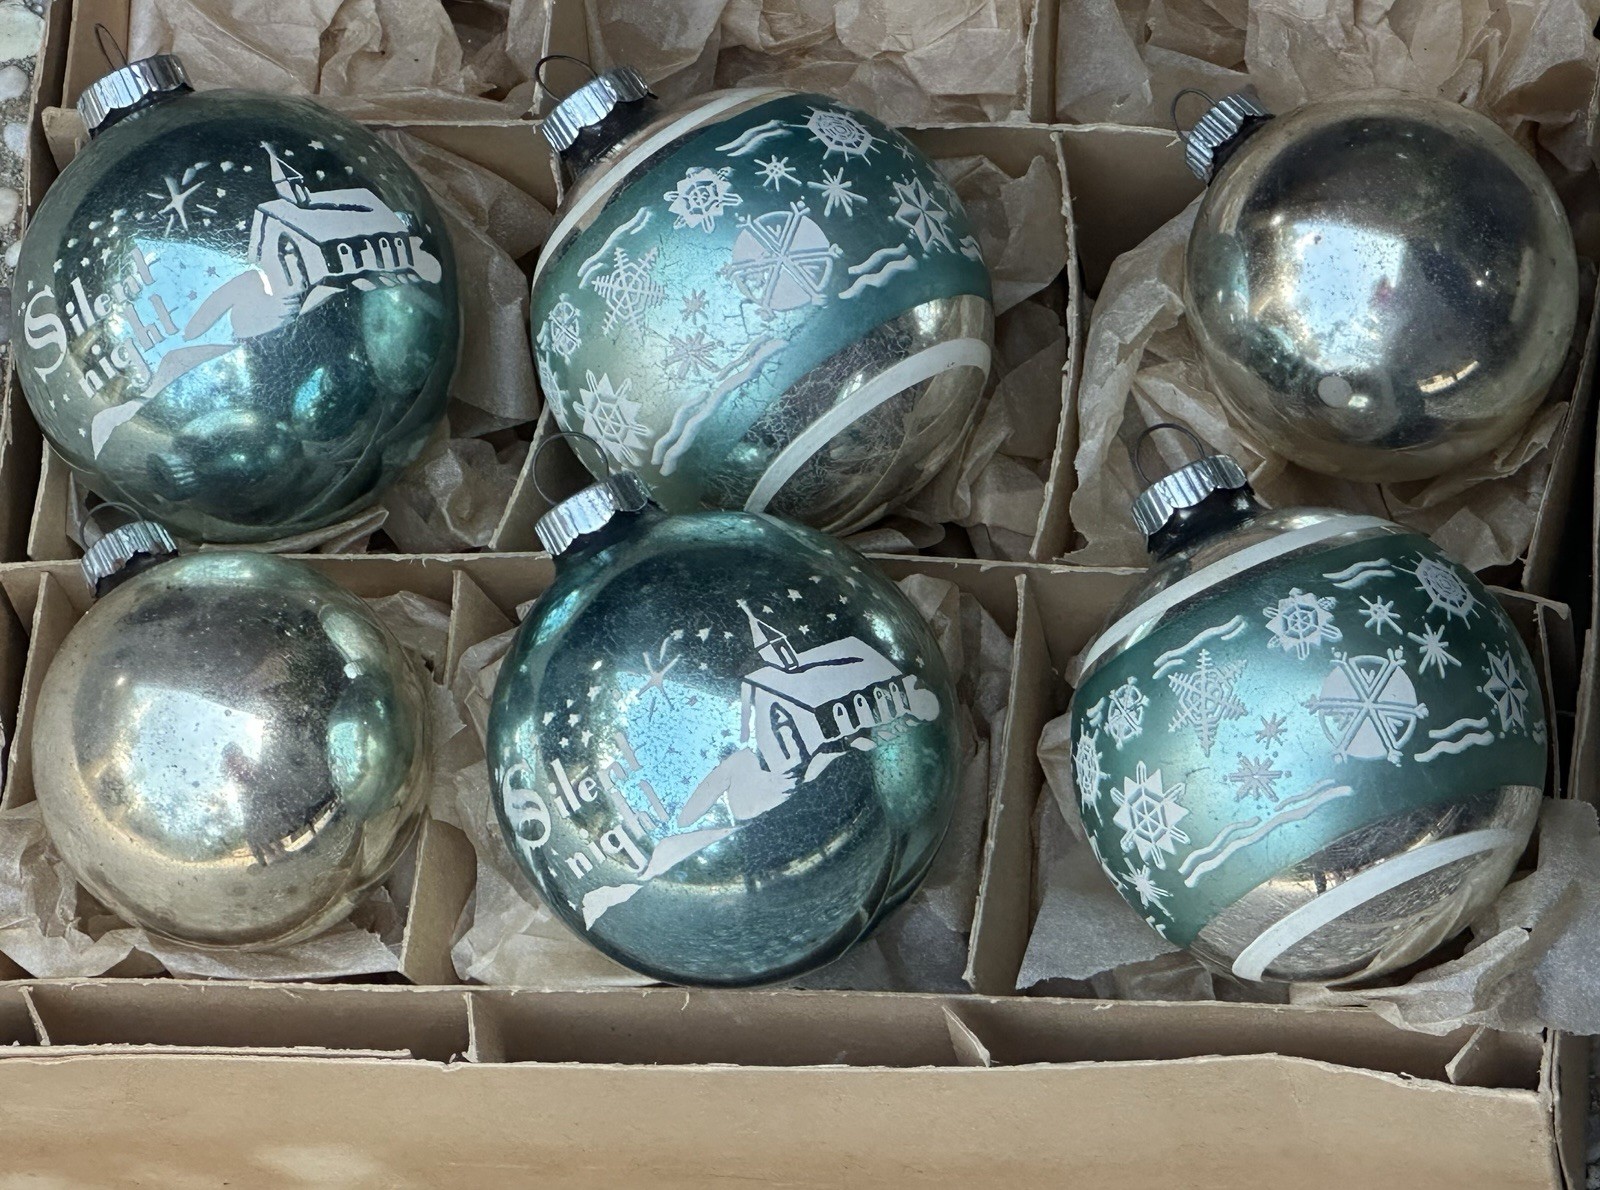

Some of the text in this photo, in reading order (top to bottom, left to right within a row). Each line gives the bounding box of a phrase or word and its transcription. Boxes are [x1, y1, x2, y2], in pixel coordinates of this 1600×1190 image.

[24, 245, 157, 382] Silent
[78, 293, 180, 399] night
[502, 731, 643, 850] Silent
[564, 778, 671, 880] night
